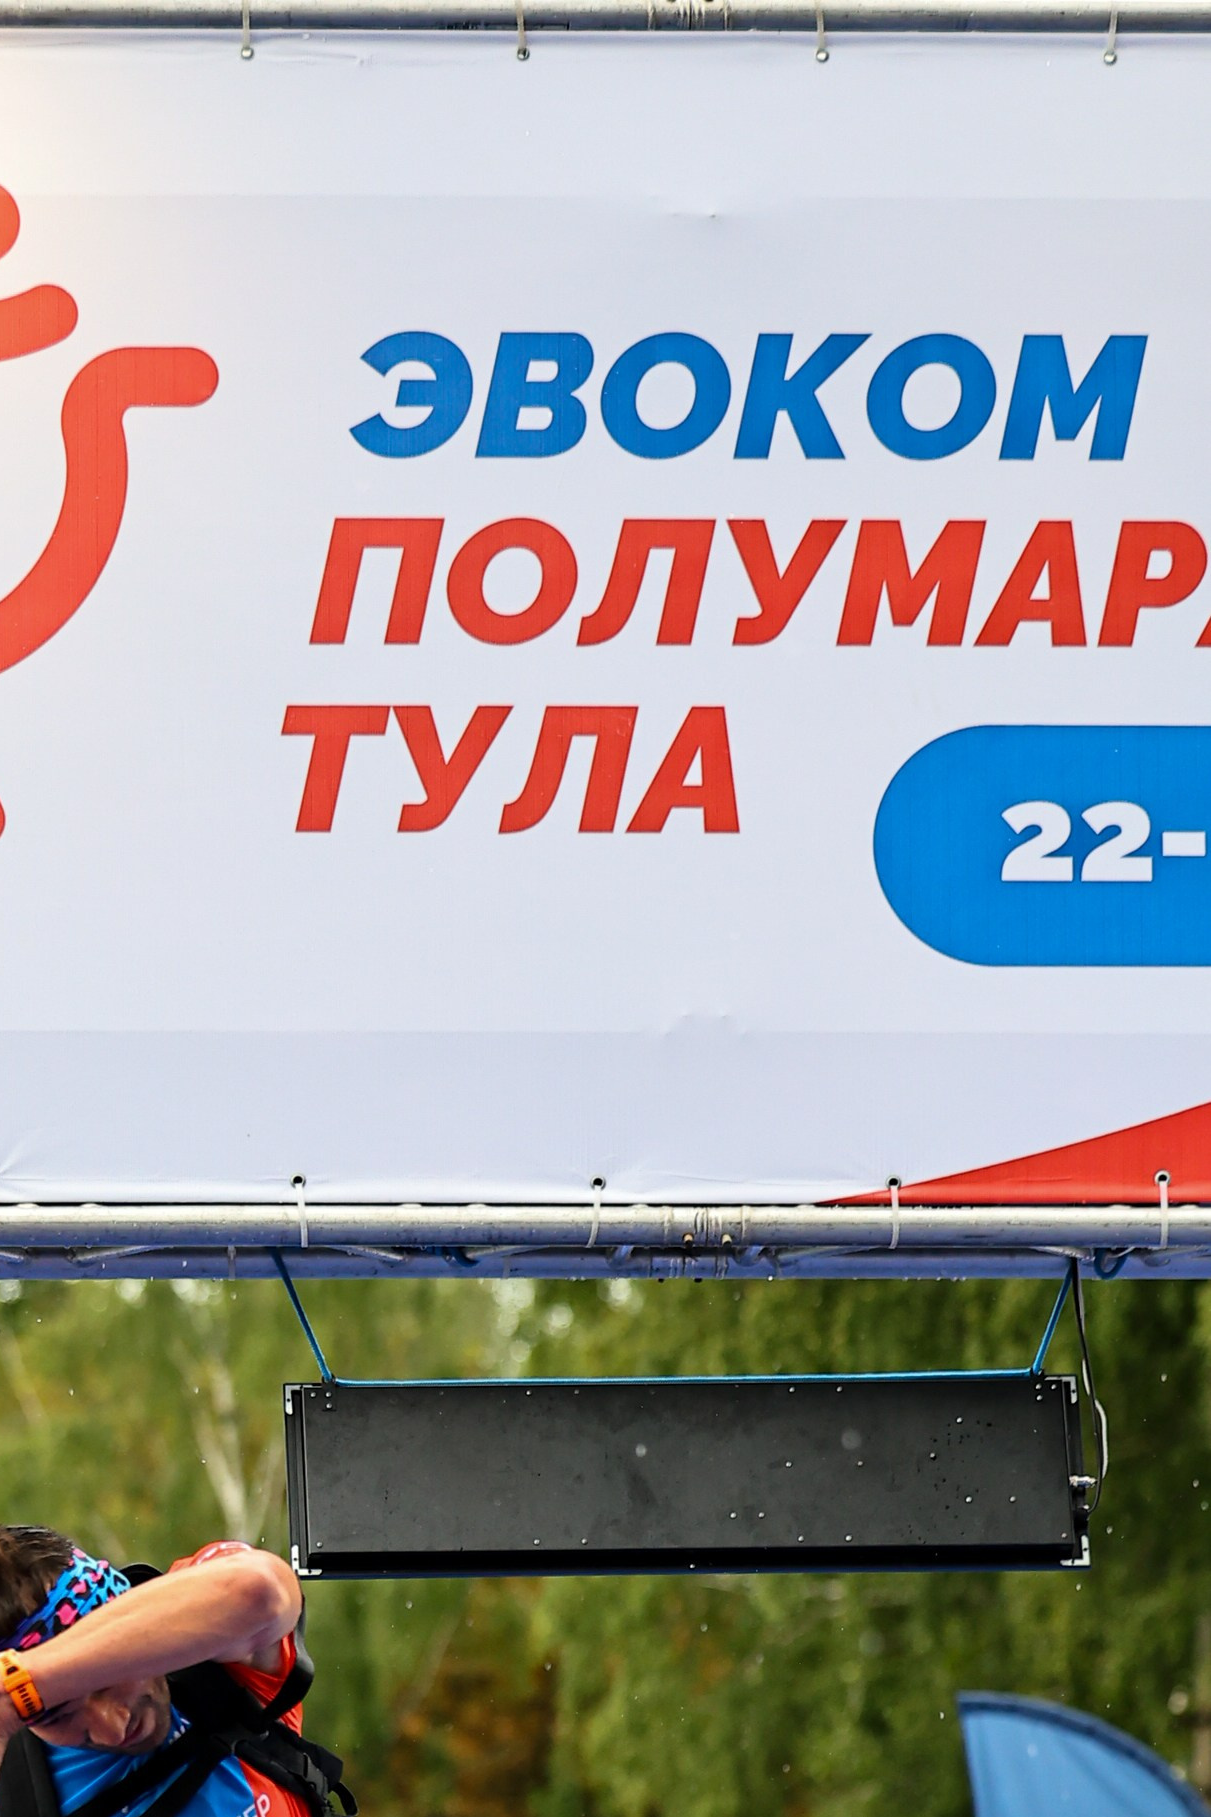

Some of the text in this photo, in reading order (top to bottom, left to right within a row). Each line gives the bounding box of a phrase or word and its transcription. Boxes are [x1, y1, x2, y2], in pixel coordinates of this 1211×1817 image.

[349, 331, 1149, 461] ЭВОКОМ
[309, 518, 1211, 647] ПОЛУМАР
[281, 705, 741, 834] ТУЛА
[1000, 800, 1207, 882] 22-
